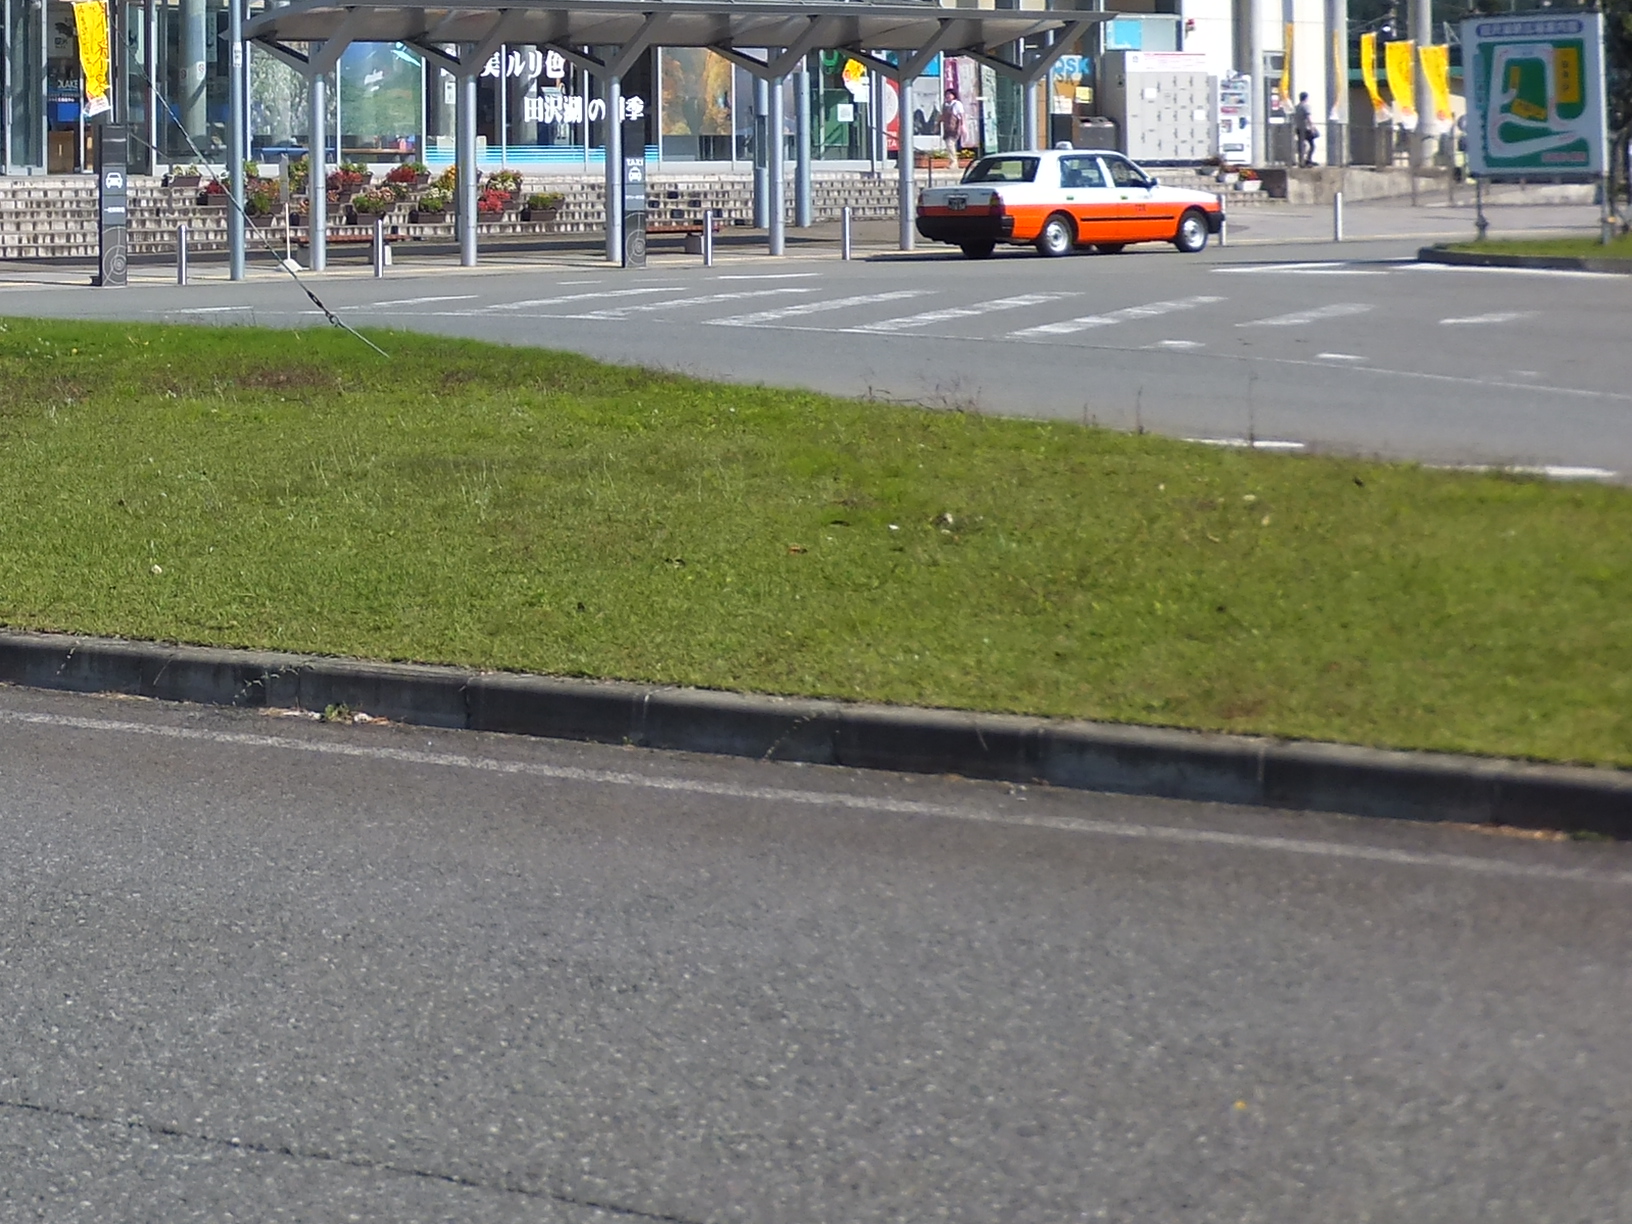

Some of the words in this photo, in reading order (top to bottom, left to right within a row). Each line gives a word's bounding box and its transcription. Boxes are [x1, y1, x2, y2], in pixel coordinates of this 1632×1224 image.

[523, 94, 645, 124] 田沢湖の季
